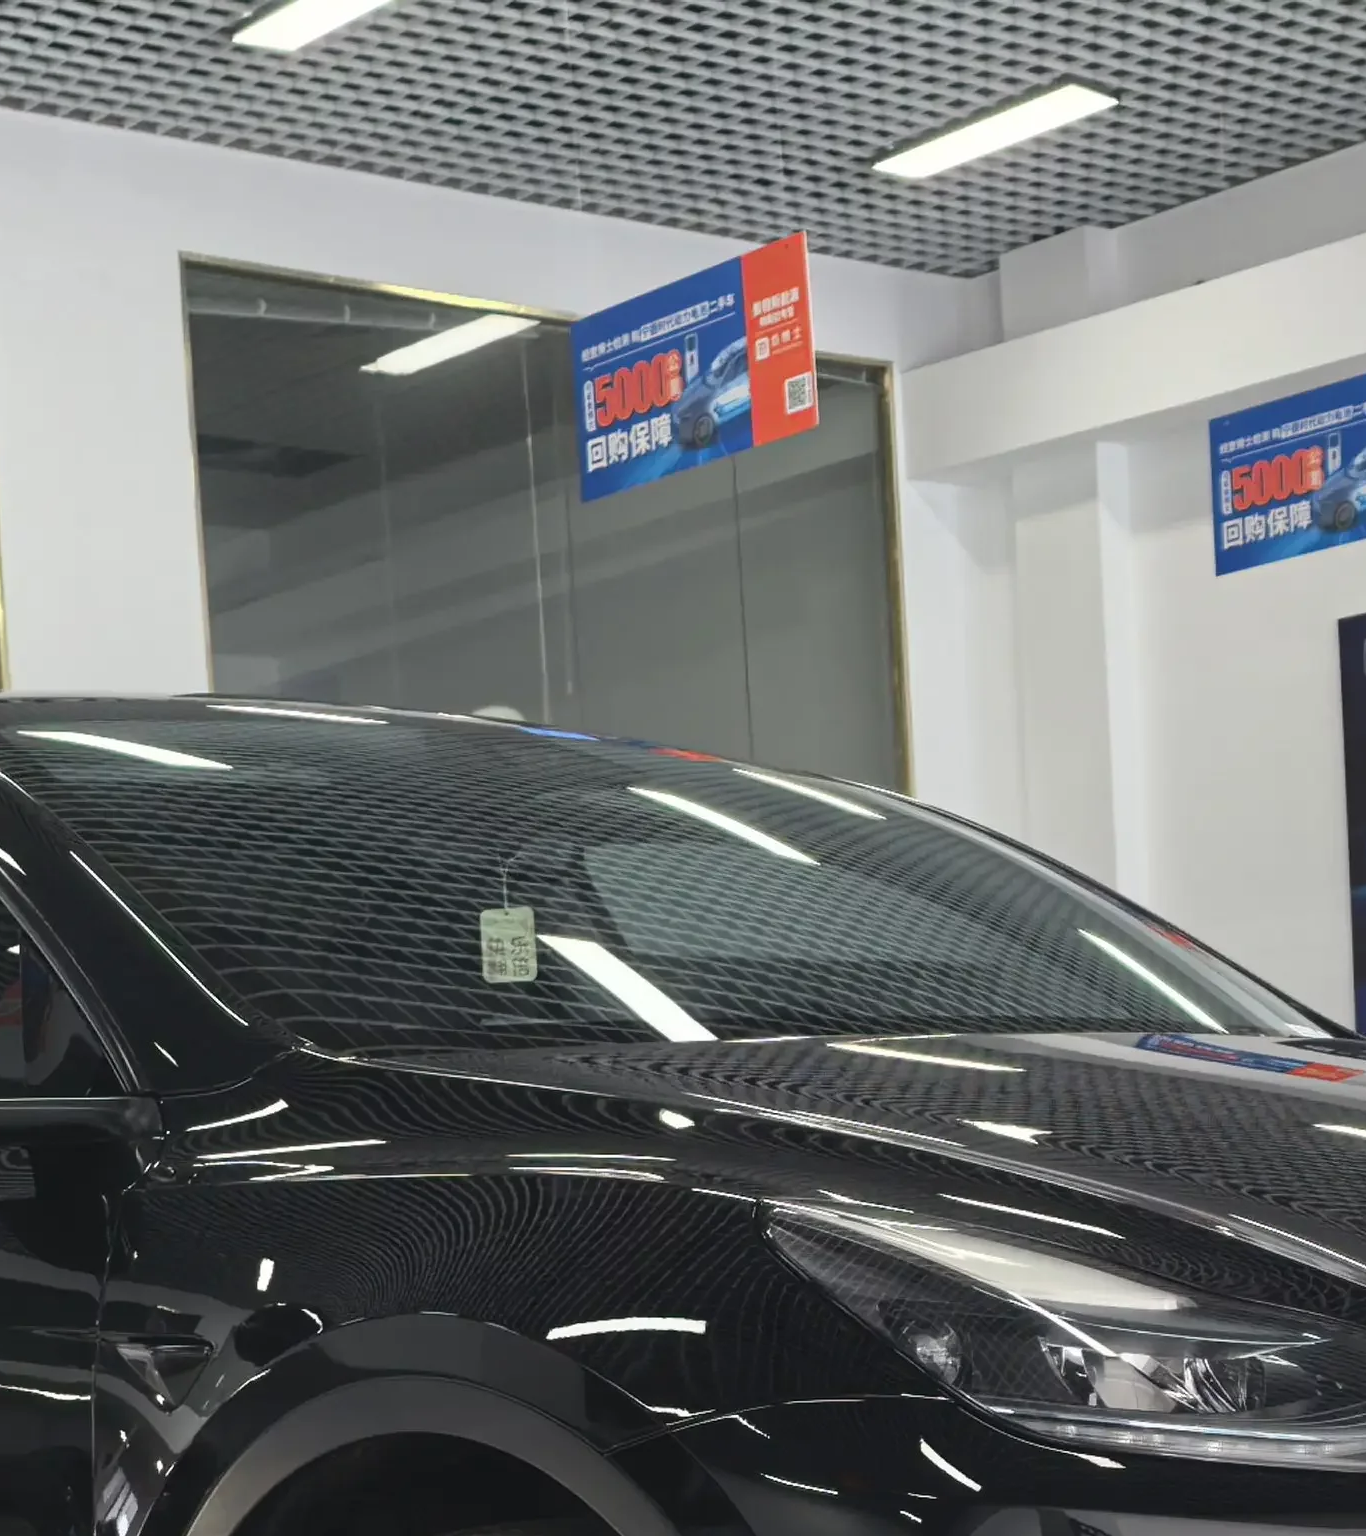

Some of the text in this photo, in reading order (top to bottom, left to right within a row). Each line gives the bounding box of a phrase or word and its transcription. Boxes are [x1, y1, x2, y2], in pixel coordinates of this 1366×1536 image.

[587, 413, 672, 473] 回购保障
[1222, 500, 1313, 550] 回购保障
